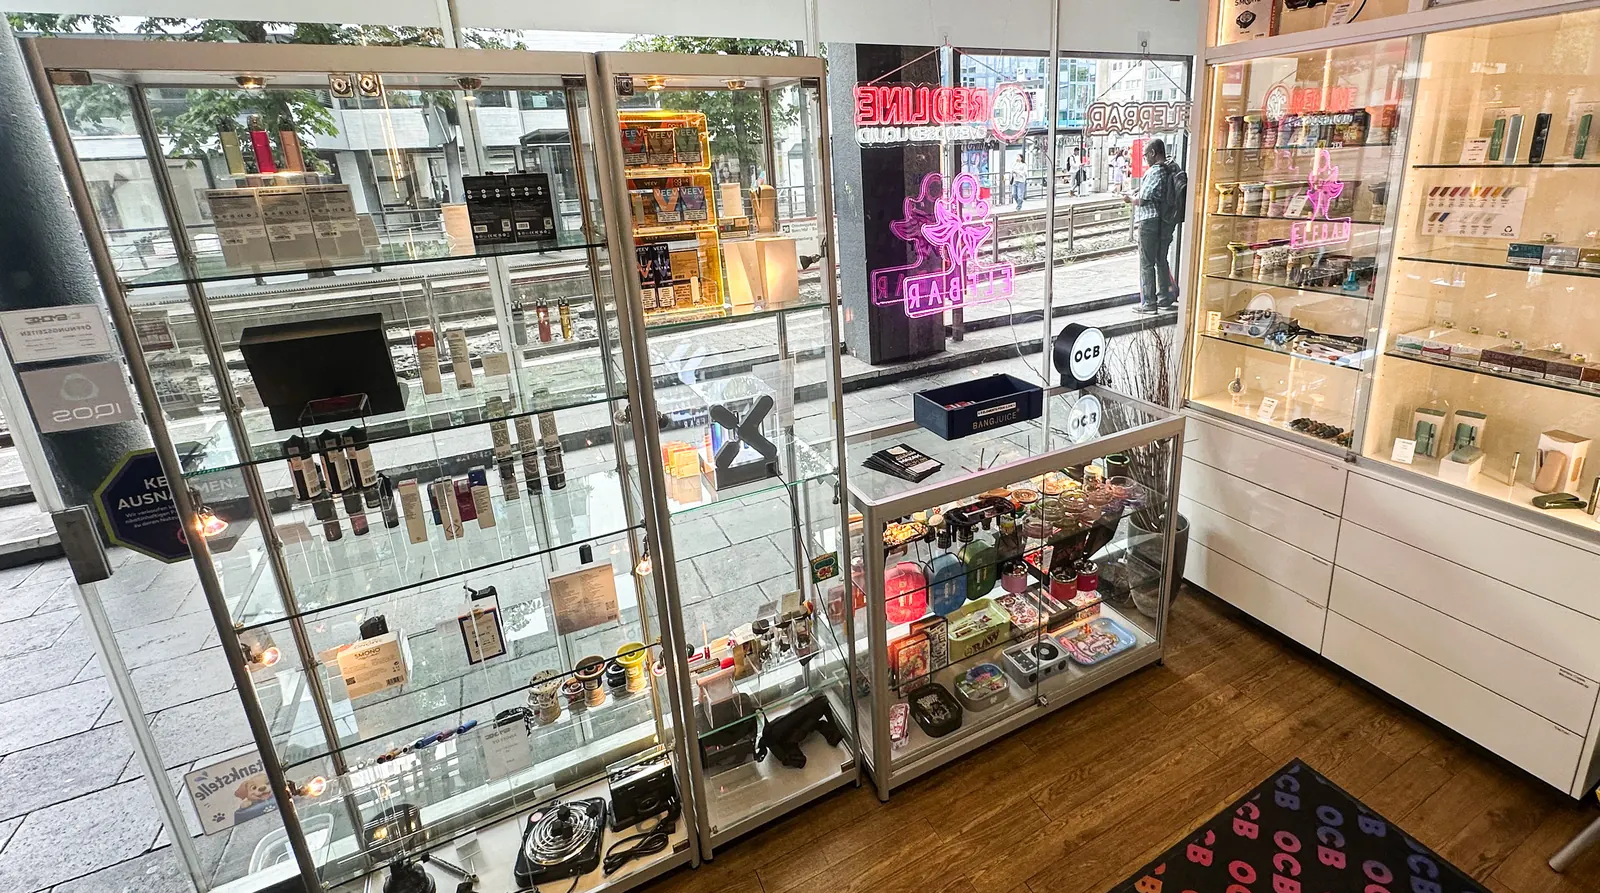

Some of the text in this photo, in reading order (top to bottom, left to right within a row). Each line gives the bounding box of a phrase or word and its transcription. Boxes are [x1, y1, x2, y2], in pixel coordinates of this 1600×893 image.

[674, 128, 698, 136] VEEV
[681, 187, 704, 195] VEEV
[1074, 345, 1101, 363] OCB
[972, 411, 1018, 430] BANGJUICE
[1315, 804, 1347, 870] OCB
[1273, 830, 1302, 893] OCB
